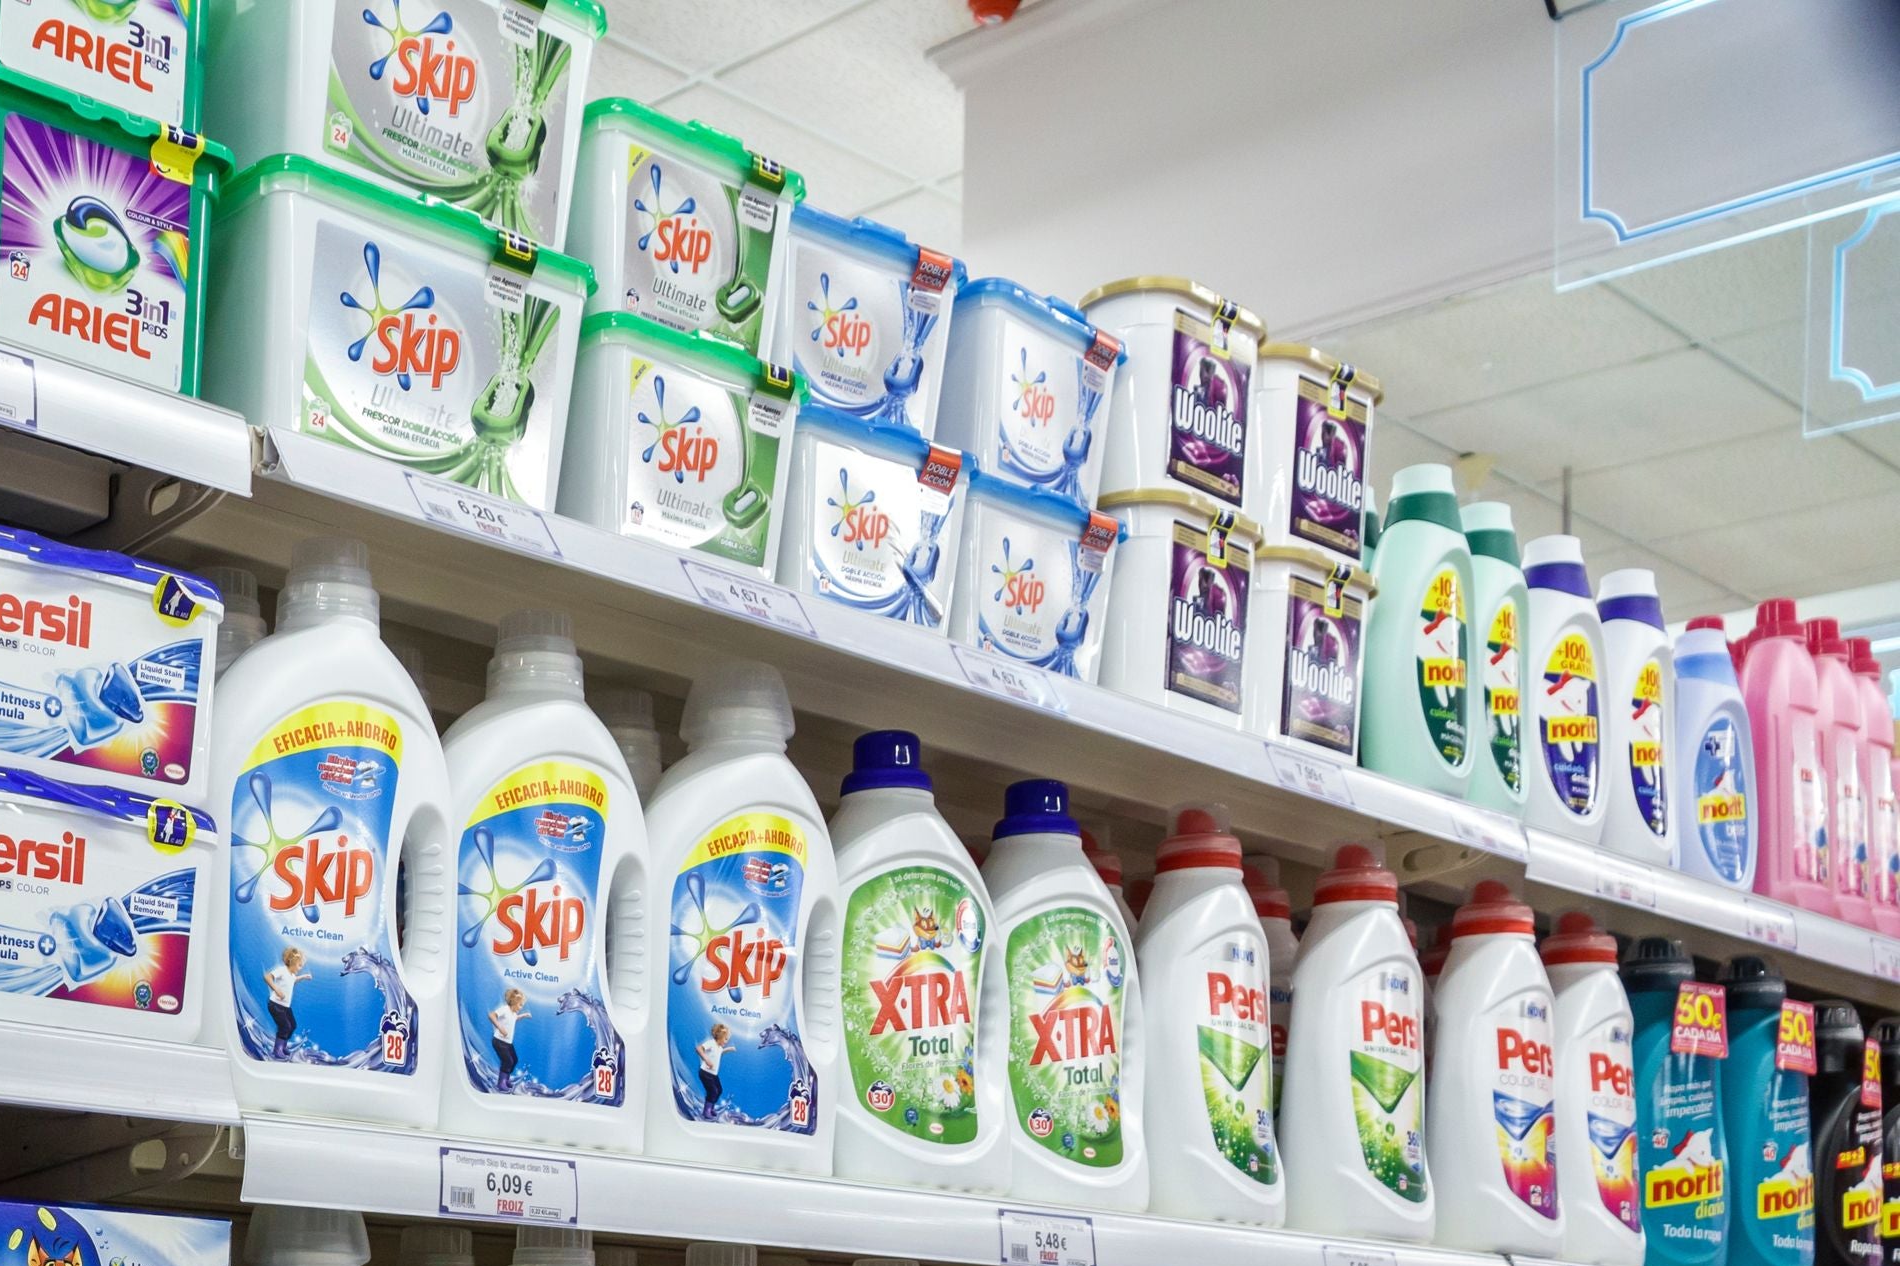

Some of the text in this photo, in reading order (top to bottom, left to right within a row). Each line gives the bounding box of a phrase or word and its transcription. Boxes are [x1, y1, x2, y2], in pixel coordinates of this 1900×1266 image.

[393, 34, 478, 116] Skip
[653, 218, 712, 274] Skip
[28, 293, 152, 360] ARIEL
[372, 314, 462, 390] Skip
[1174, 384, 1243, 454] Woolite
[927, 462, 957, 478] DOBLE
[1298, 448, 1362, 511] Woolite
[843, 507, 889, 546] Skip
[1552, 719, 1597, 740] norit
[17, 883, 49, 896] COLOR
[281, 925, 344, 942] Active Clean
[504, 967, 559, 983] Active Clean
[387, 1036, 402, 1059] 28
[908, 1036, 954, 1056] Total
[598, 1070, 612, 1094] 28
[1063, 1062, 1103, 1086] Total
